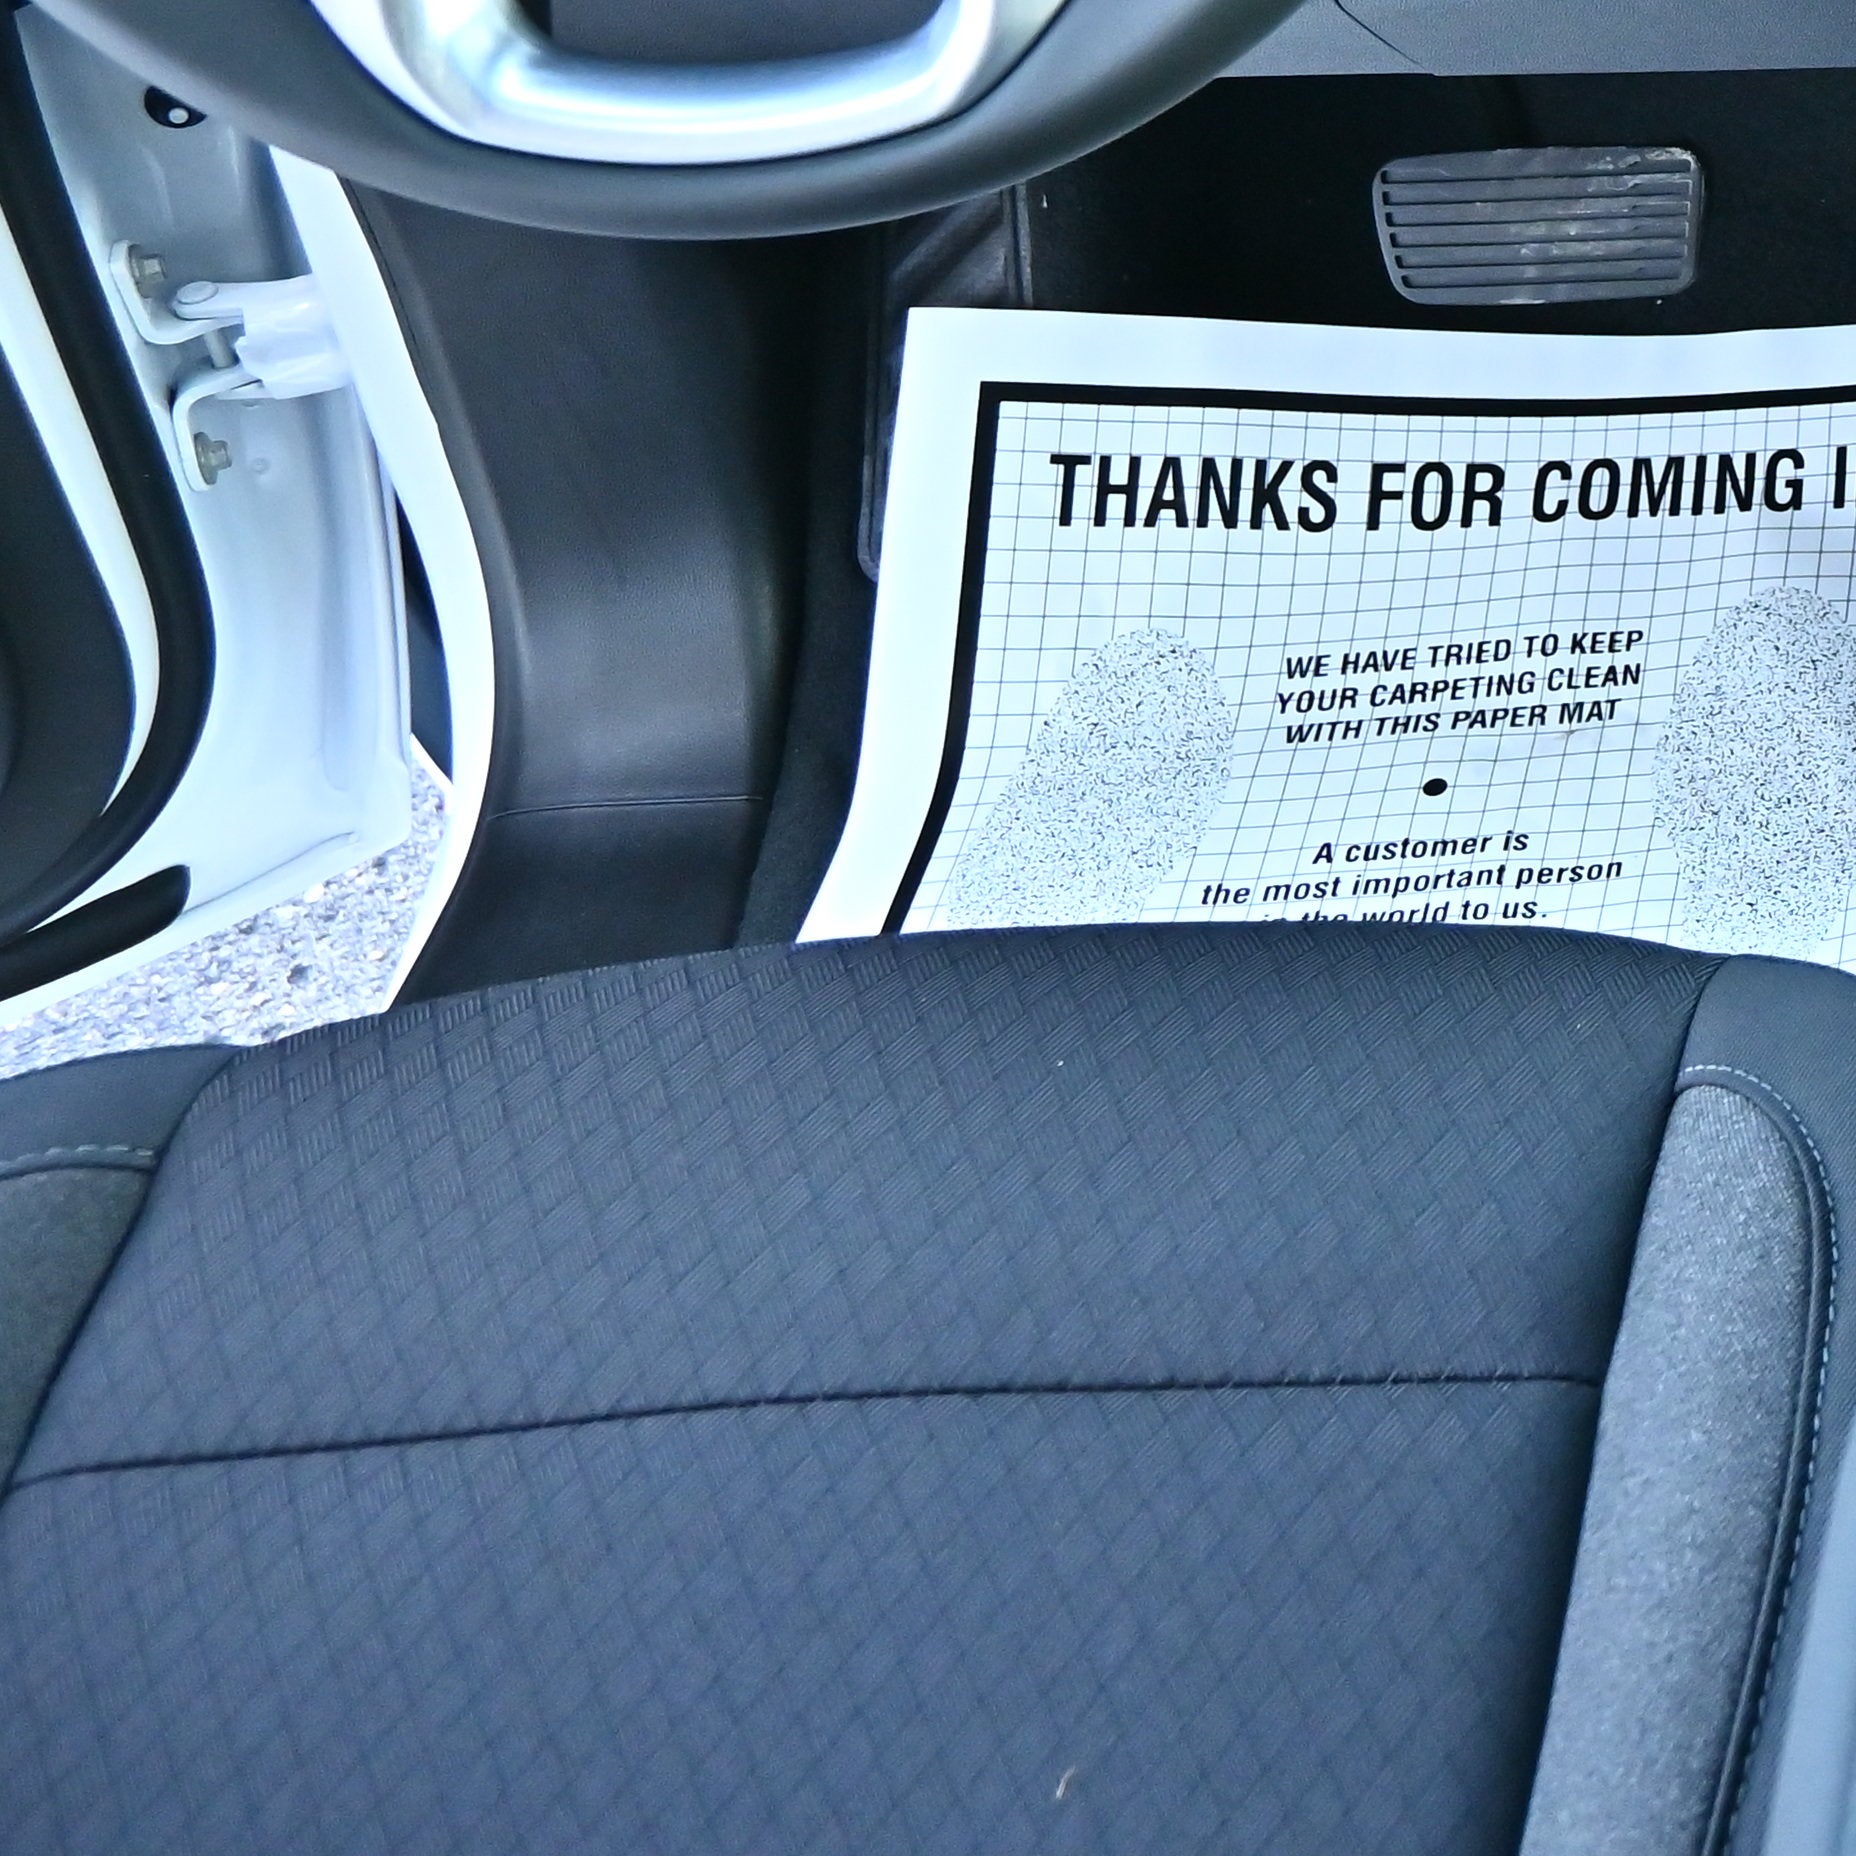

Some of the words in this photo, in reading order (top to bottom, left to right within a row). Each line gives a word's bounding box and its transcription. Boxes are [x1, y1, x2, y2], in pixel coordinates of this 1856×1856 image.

[1051, 453, 1338, 533] THANKS
[1366, 461, 1505, 531] FOR
[1531, 448, 1805, 523] COMING
[1285, 652, 1330, 679] WE
[1339, 645, 1417, 676] HAVE
[1427, 637, 1514, 670] TRIED
[1523, 633, 1560, 661] TO
[1570, 629, 1644, 656] KEEP
[1277, 684, 1358, 714] YOUR
[1369, 671, 1537, 708] CARPETING
[1546, 663, 1642, 694] CLEAN
[1286, 718, 1361, 744] WITH
[1377, 710, 1441, 739] THIS
[1450, 704, 1547, 734] PAPER
[1557, 698, 1622, 724] MAT
[1312, 842, 1334, 865] A
[1345, 834, 1492, 863] customer
[1502, 830, 1529, 853] is
[1201, 883, 1250, 905] the
[1263, 877, 1341, 903] most
[1352, 863, 1506, 900] important
[1515, 861, 1624, 890] person
[1361, 901, 1449, 924] world
[1461, 900, 1490, 921] to
[1502, 901, 1549, 921] us.
